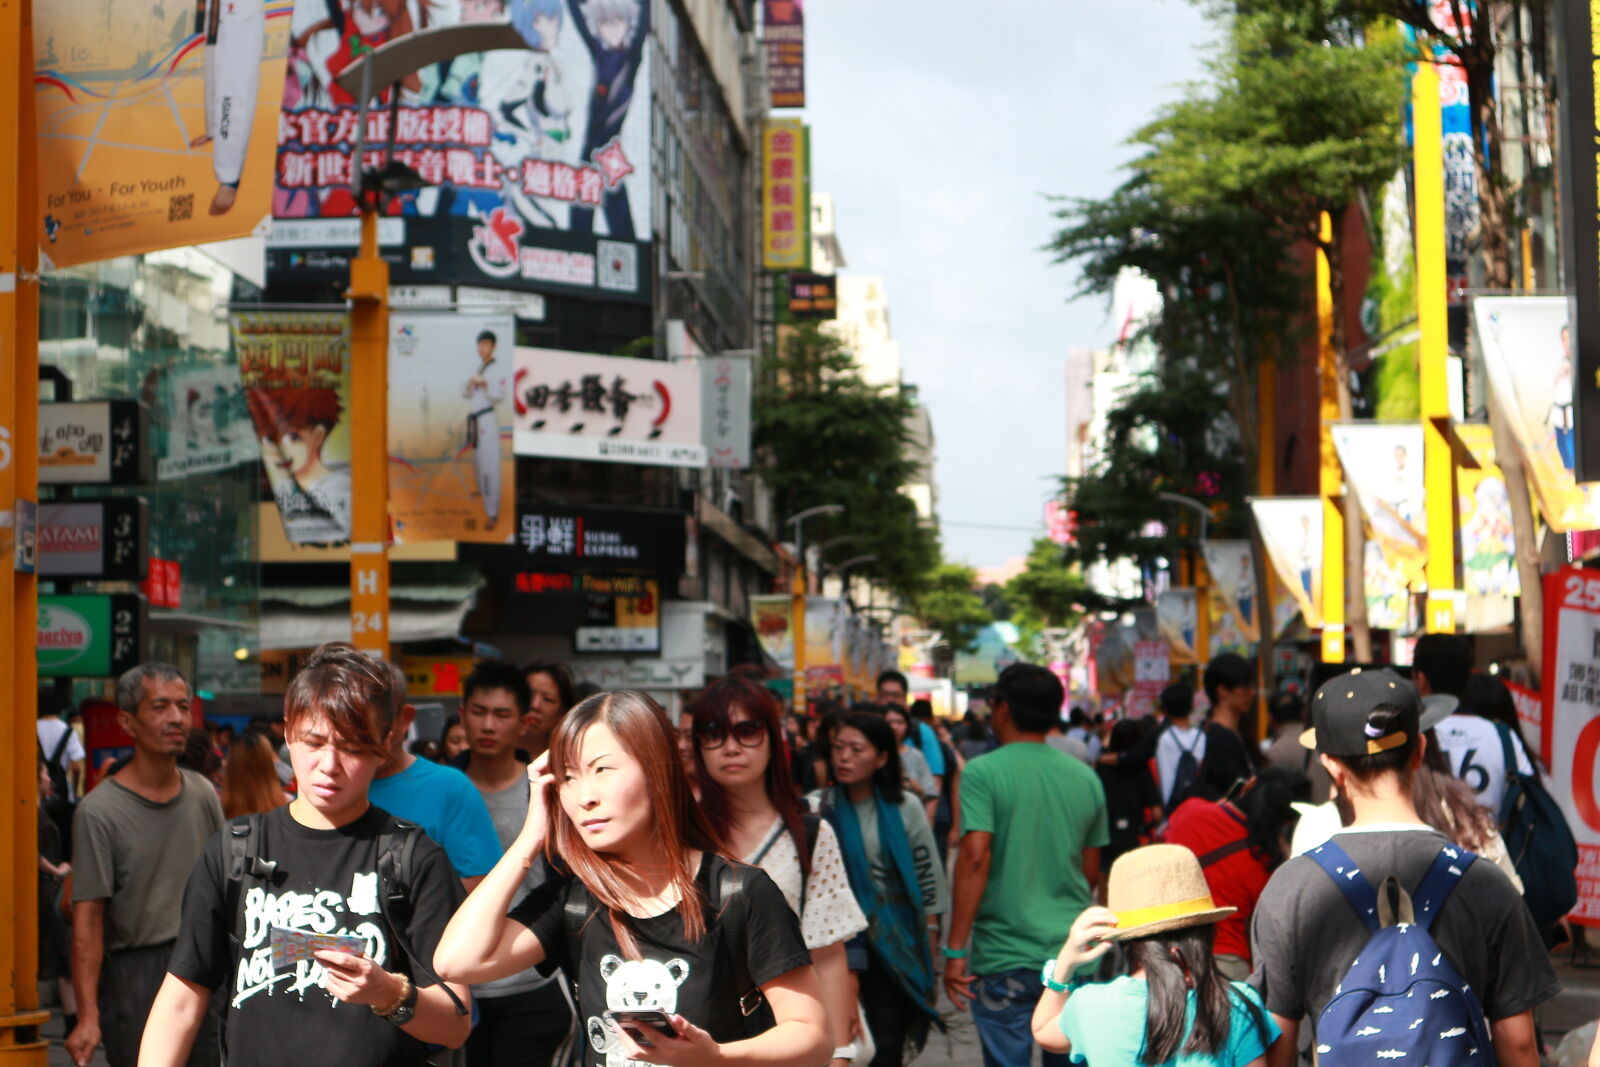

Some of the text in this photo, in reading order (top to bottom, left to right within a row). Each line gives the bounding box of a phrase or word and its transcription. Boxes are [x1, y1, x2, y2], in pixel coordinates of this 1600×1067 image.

[48, 194, 65, 208] For
[67, 190, 91, 203] You
[110, 182, 136, 196] For
[140, 175, 186, 193] Youth
[520, 514, 574, 553] 爭鮮
[584, 532, 620, 543] SUSHI
[584, 545, 638, 558] EXPRESS
[357, 570, 378, 595] H
[353, 612, 382, 632] 24
